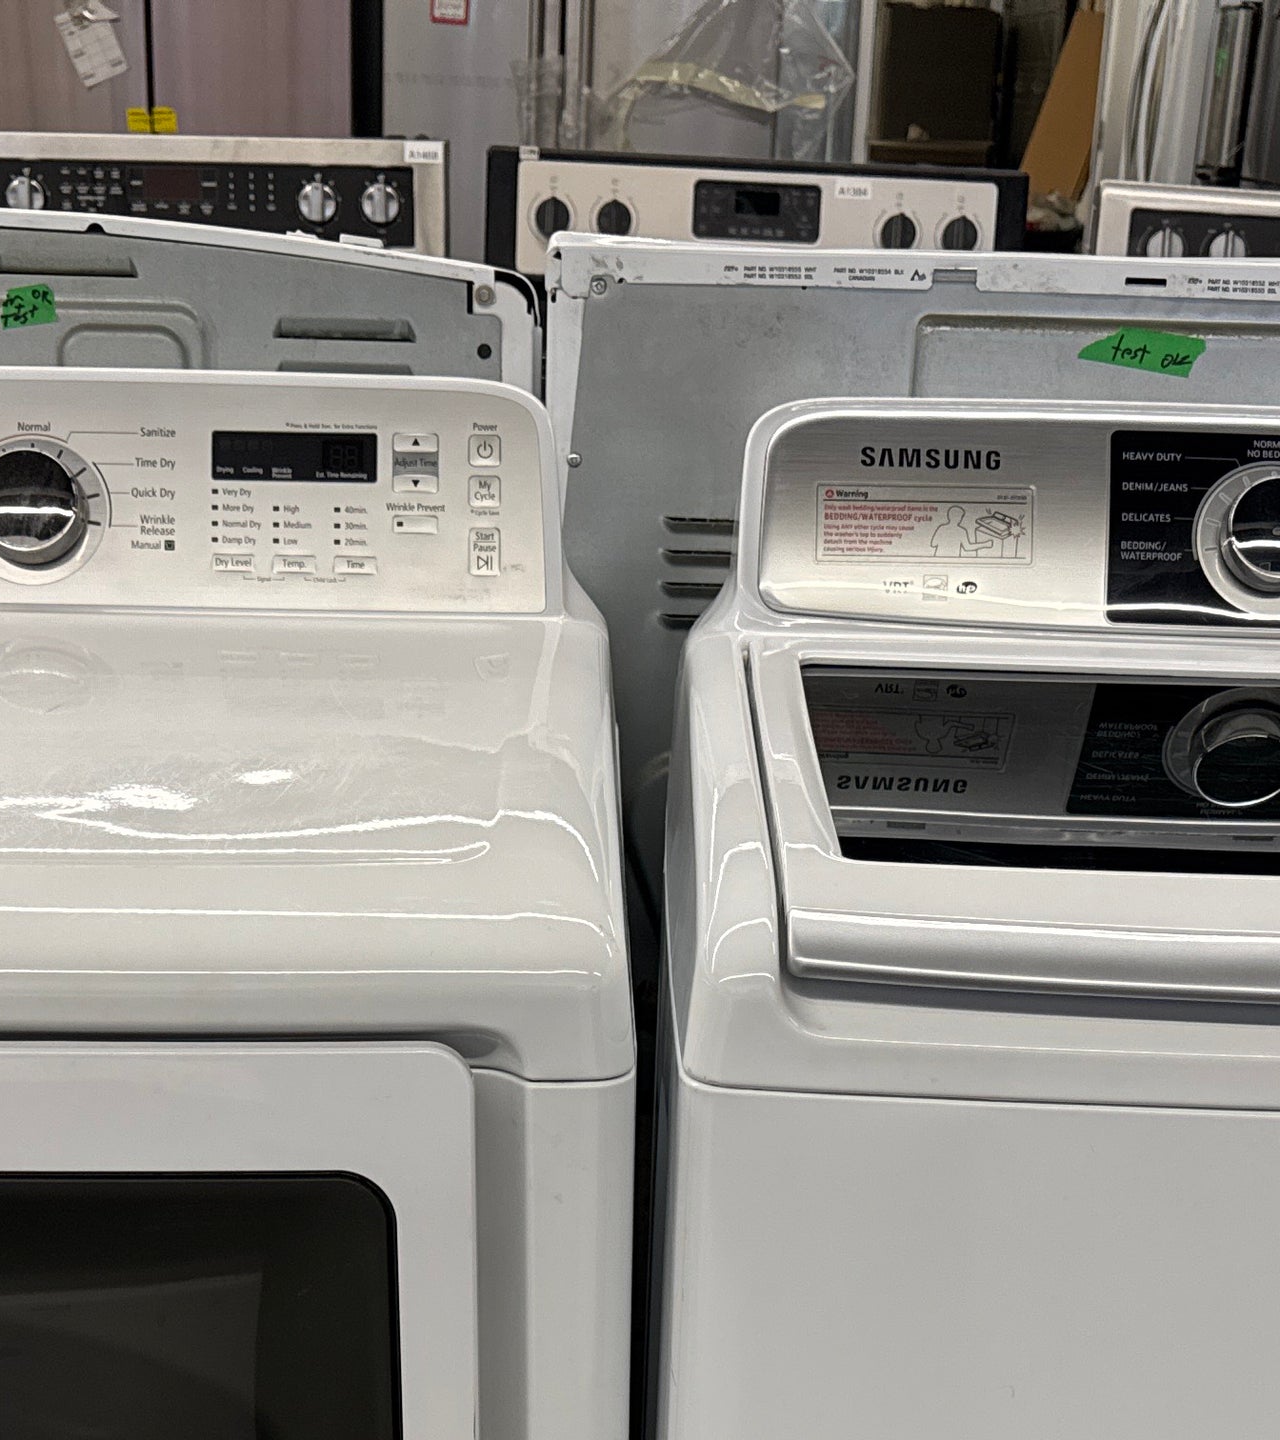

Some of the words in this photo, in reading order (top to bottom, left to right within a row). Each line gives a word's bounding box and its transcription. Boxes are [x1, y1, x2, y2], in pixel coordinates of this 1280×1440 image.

[17, 421, 51, 433] Normal
[472, 422, 498, 432] Power
[140, 427, 176, 438] Sanitize
[860, 446, 1001, 471] SAMSUNG
[1122, 452, 1154, 462] HEAVY
[1156, 453, 1182, 462] DUTY
[1247, 449, 1260, 458] NO
[135, 457, 158, 468] Time
[160, 458, 176, 470] Dry
[394, 457, 418, 469] Adjust
[419, 458, 438, 468] Time
[478, 480, 492, 492] My
[1121, 482, 1188, 493] DENIM/JEANS
[131, 487, 156, 498] Quick
[159, 488, 176, 500] Dry
[222, 488, 238, 498] Very
[239, 488, 252, 498] Dry
[474, 491, 496, 502] Cycle
[835, 489, 869, 500] Warning
[222, 504, 240, 512] More
[242, 504, 254, 514] Dry
[283, 505, 300, 514] High
[386, 502, 414, 512] Wrinkle
[416, 503, 445, 513] Prevent
[140, 514, 176, 525] Wrinkle
[824, 512, 913, 522] BEDDING/WATERPROOF
[1121, 513, 1171, 522] DELICATES
[249, 521, 261, 530] Dry
[283, 521, 312, 529] Medium
[140, 525, 176, 536] Release
[475, 531, 494, 541] Start
[131, 540, 162, 550] Manual
[222, 537, 243, 546] Damp
[244, 537, 256, 546] Dry
[1120, 540, 1167, 551] BEDDING/
[473, 543, 497, 553] Pause
[1120, 551, 1183, 562] WATERPROOF
[215, 558, 229, 567] Dry
[231, 558, 252, 567] Level
[346, 560, 365, 569] Time
